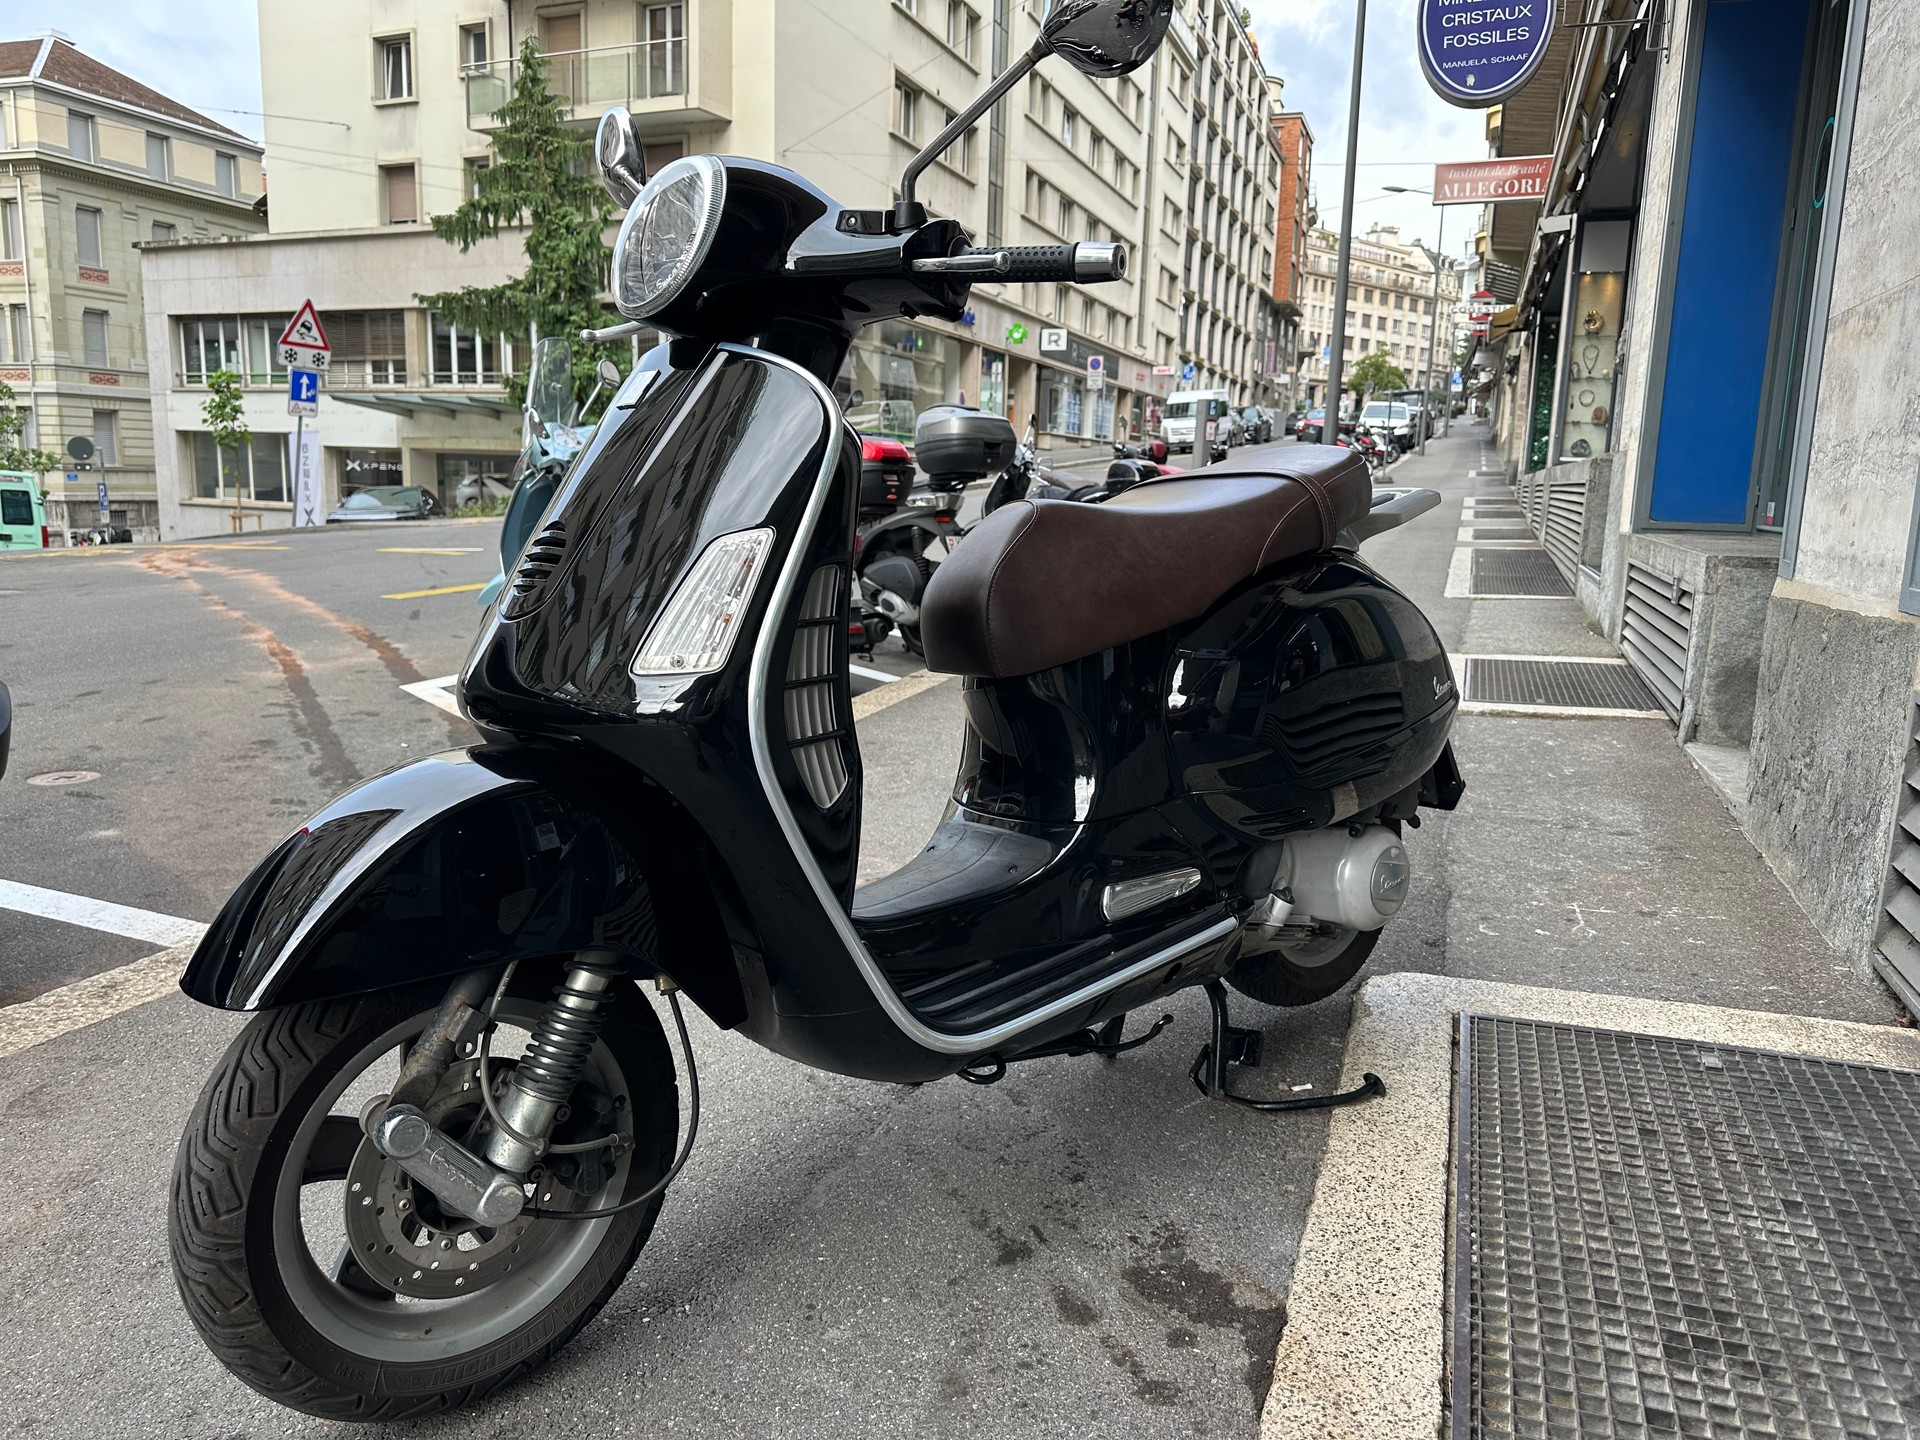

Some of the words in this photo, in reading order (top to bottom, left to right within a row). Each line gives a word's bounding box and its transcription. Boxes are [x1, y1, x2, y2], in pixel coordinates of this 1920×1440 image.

[1441, 4, 1532, 27] CRISTAUX
[1443, 26, 1529, 49] FOSSILES
[1442, 58, 1488, 69] MANUELA
[1490, 53, 1529, 64] SCHAAF
[1448, 166, 1489, 179] Institut
[1491, 164, 1506, 177] de
[1507, 161, 1547, 176] Beauté
[1047, 332, 1061, 347] R
[430, 1324, 553, 1384] MICHELIN
